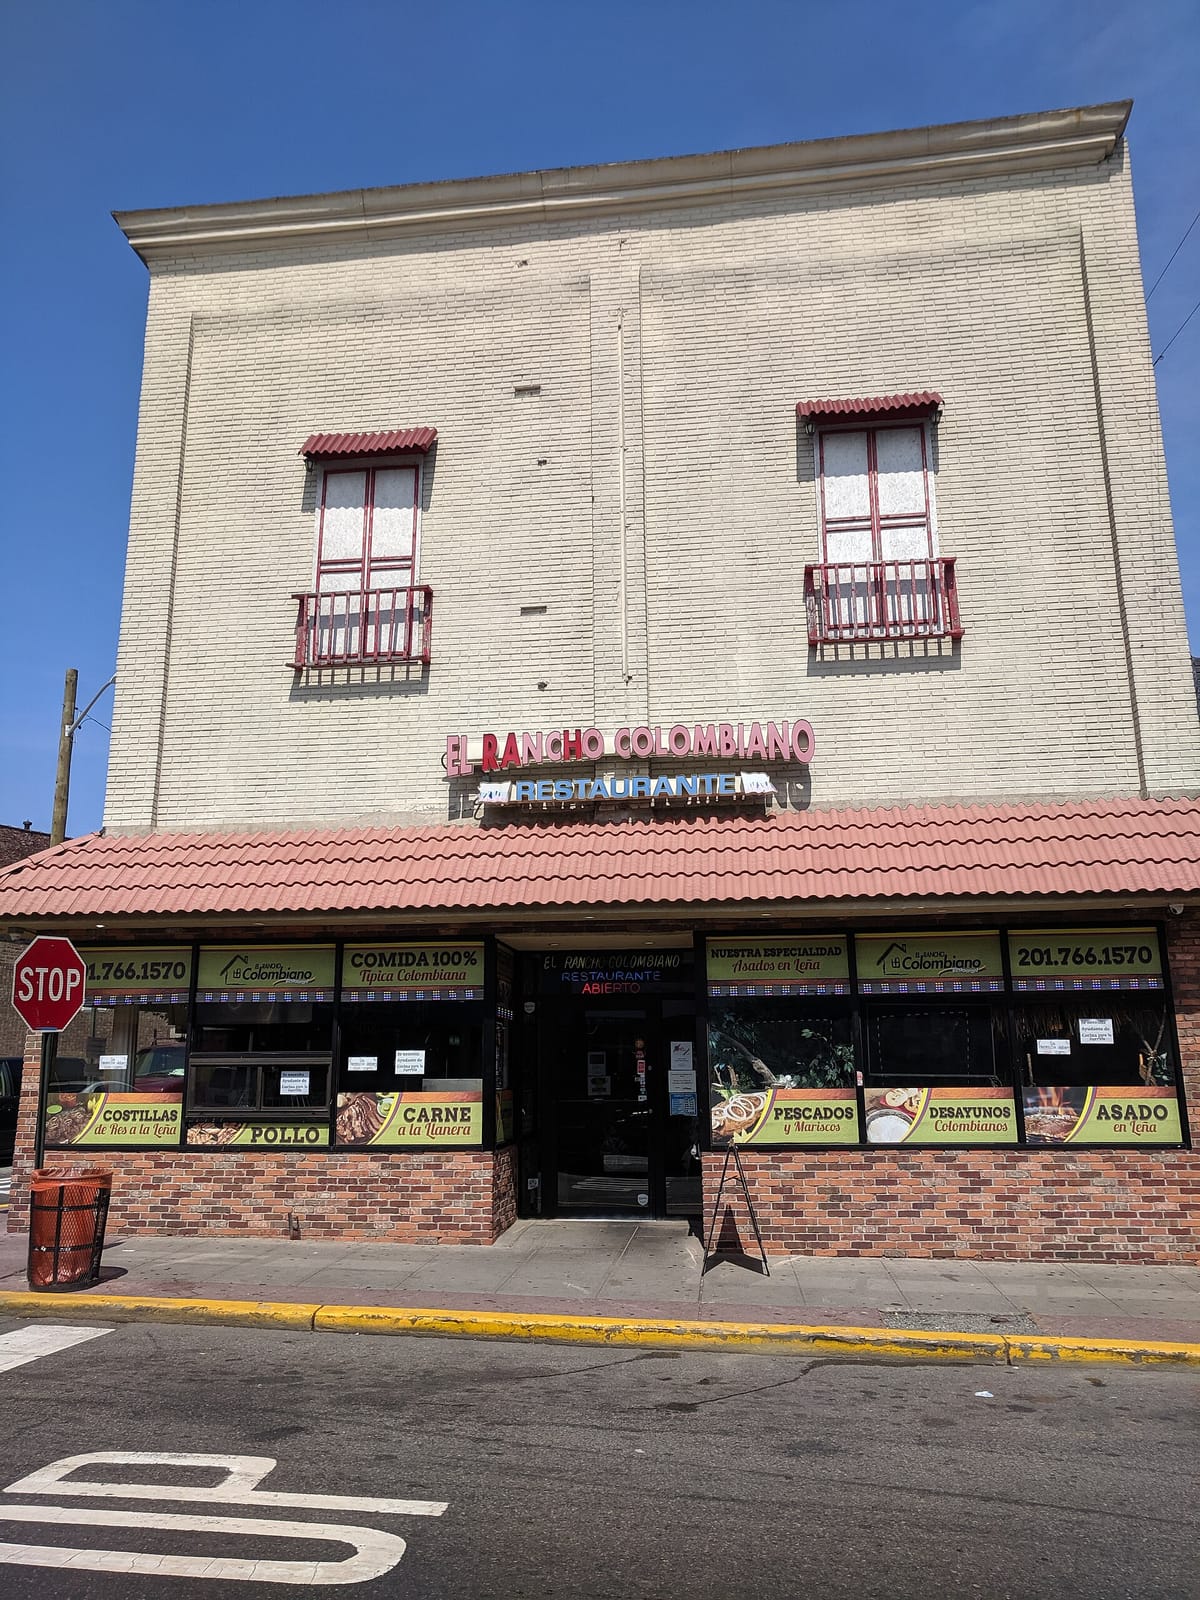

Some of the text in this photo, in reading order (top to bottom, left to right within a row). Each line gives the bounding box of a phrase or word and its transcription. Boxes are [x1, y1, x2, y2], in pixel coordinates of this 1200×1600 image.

[446, 719, 815, 777] EL RANCHO COLOMBIANO
[515, 773, 736, 801] RESTAURANTE
[351, 951, 478, 968] COMIDA 100%
[711, 947, 842, 958] NUESTRA ESPECIALIDAD
[1017, 946, 1152, 966] 201.766.1570
[608, 954, 681, 969] COLOMBIANO
[732, 959, 821, 974] Asados en Leña
[902, 954, 981, 970] Colombiano
[86, 962, 186, 981] 1.766.1570
[242, 966, 312, 980] Colombiano
[397, 969, 467, 981] Colombiana
[561, 970, 663, 982] RESTAURANTE
[18, 966, 81, 1002] STOP
[581, 982, 640, 995] ABIERTO
[103, 1109, 178, 1122] COSTILLAS
[403, 1107, 471, 1123] CARNE
[774, 1107, 854, 1120] PESCADOS
[929, 1107, 1011, 1119] DESAYUNOS
[1096, 1104, 1168, 1120] ASADO
[95, 1123, 177, 1138] de Res a la Leña
[398, 1122, 471, 1139] a la Llanera
[784, 1121, 841, 1135] y Mariscos
[935, 1120, 1008, 1132] Colombianos
[1113, 1120, 1157, 1137] en Leña
[250, 1127, 319, 1143] POLLO
